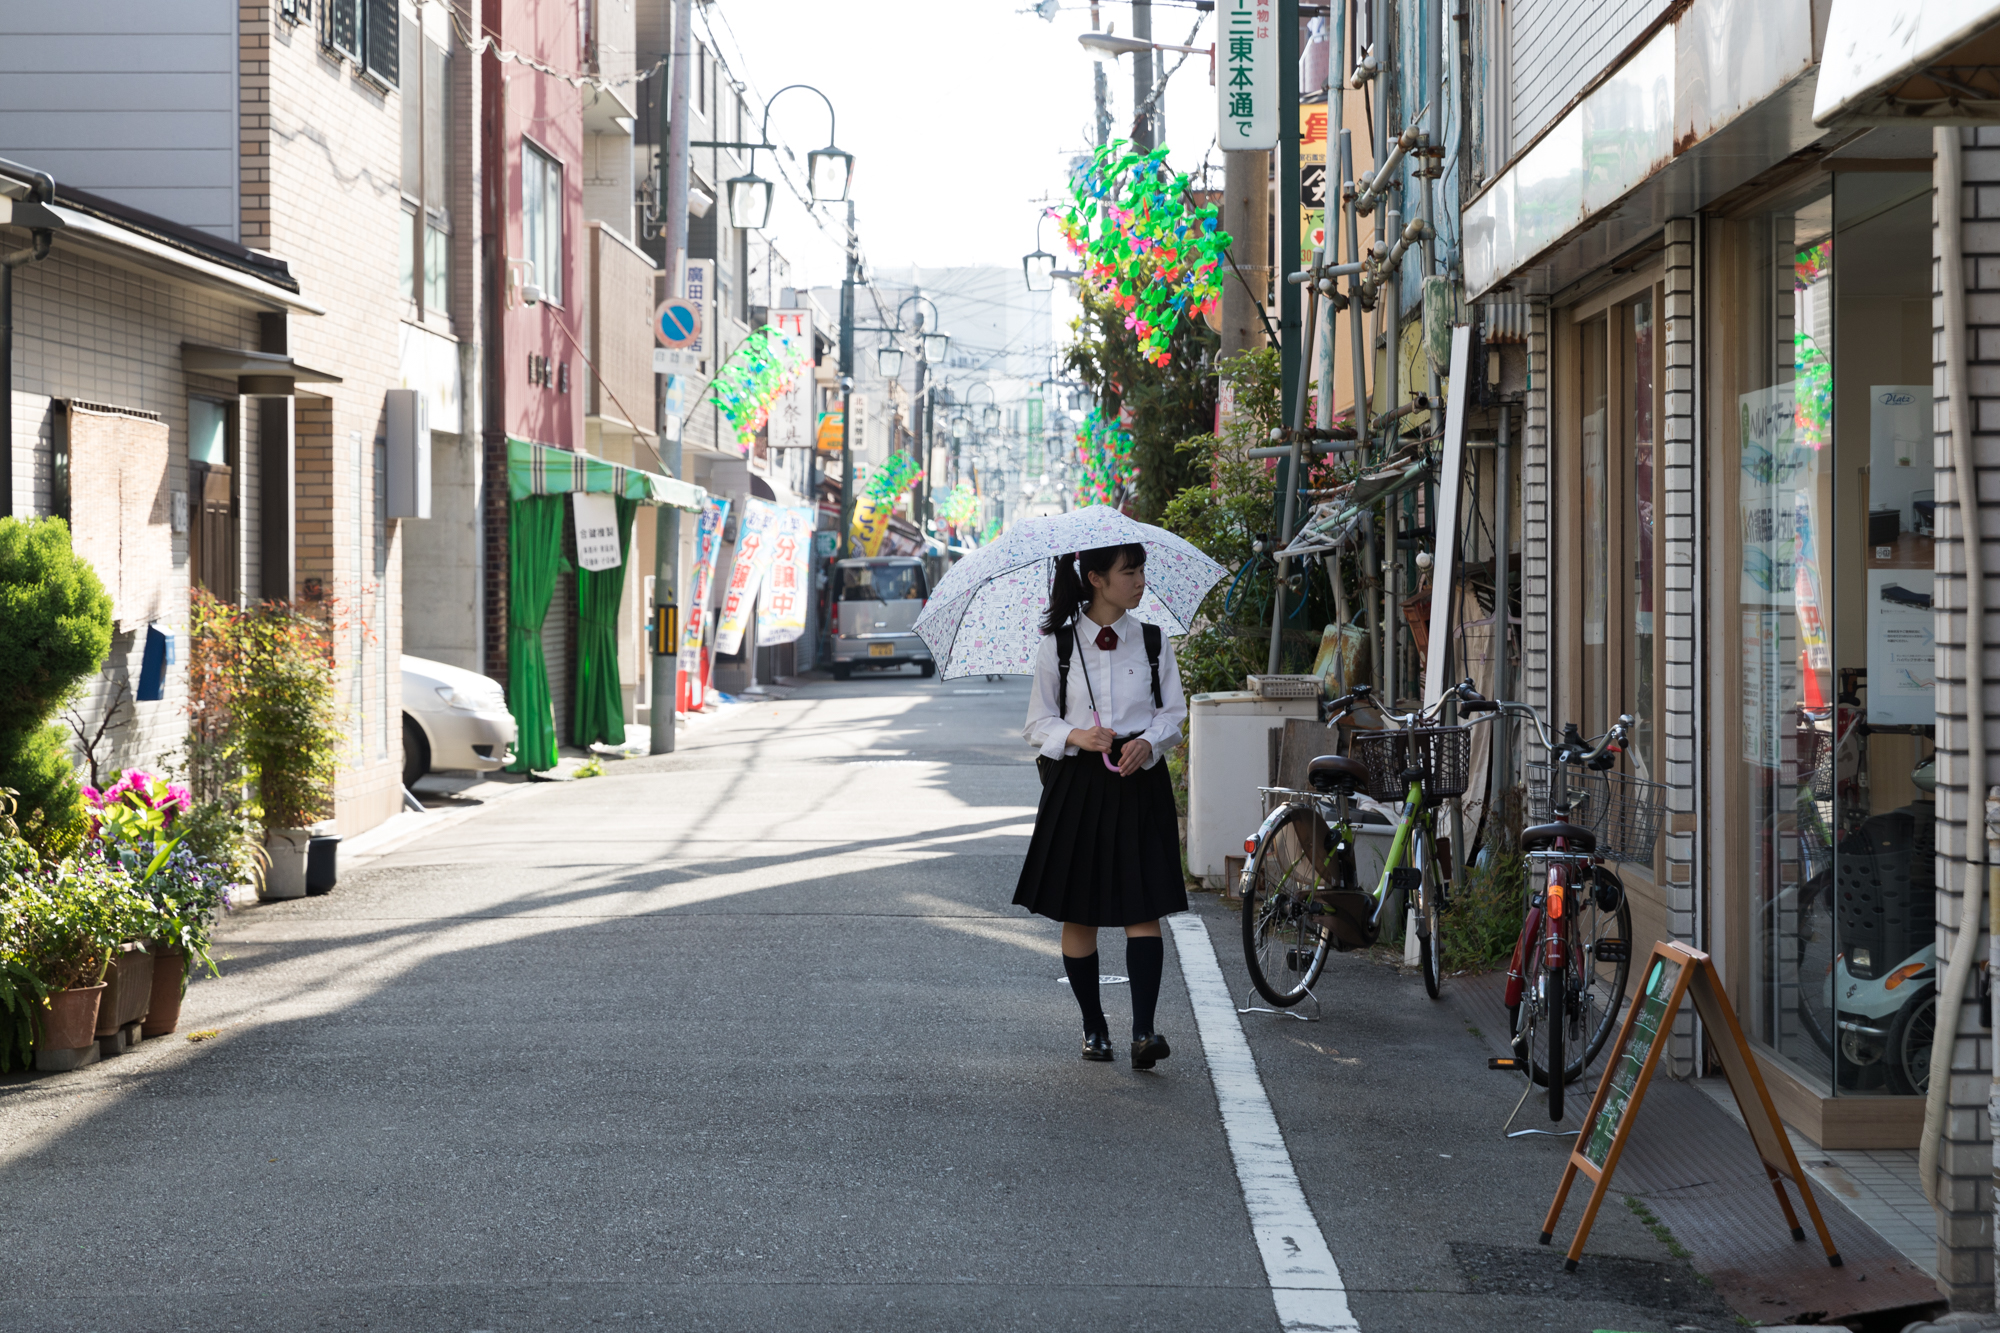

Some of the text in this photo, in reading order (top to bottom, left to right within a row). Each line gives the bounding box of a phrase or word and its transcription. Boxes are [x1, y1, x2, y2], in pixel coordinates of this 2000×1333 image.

[725, 535, 760, 618] 分譲中
[772, 537, 797, 616] 分譲中
